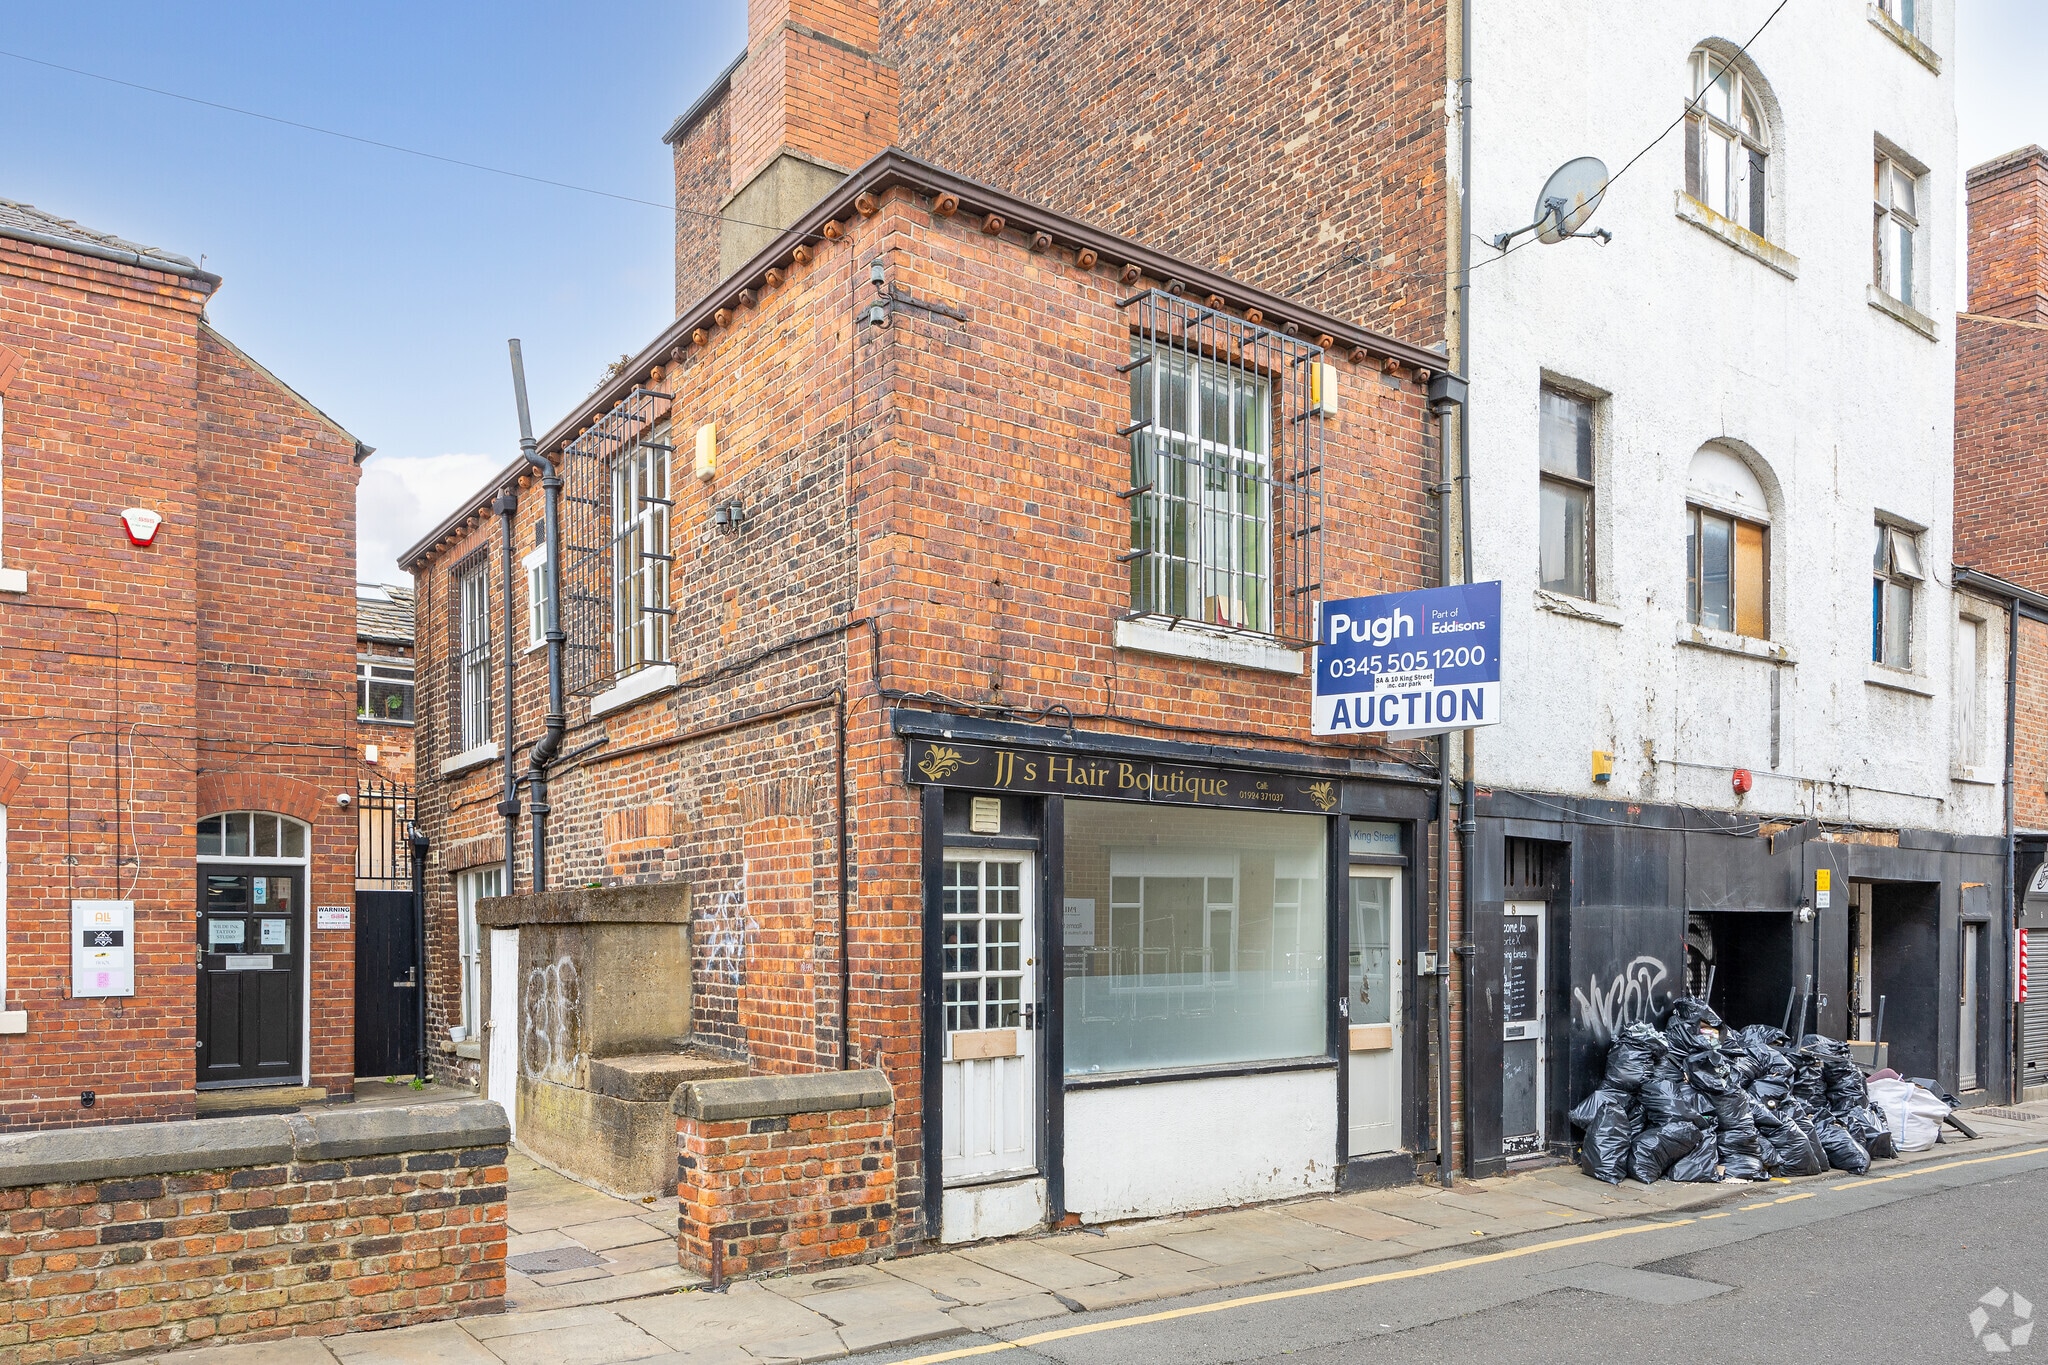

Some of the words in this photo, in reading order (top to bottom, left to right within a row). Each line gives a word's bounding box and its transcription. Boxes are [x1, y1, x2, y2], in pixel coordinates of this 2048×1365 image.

[1432, 609, 1448, 619] Part
[1450, 607, 1459, 618] of
[1330, 607, 1414, 647] Pugh
[1431, 620, 1486, 635] Eddisons
[1329, 655, 1382, 679] 0345
[1387, 650, 1428, 673] 505
[1432, 645, 1486, 669] 1200
[1414, 673, 1433, 681] Street
[1330, 687, 1484, 730] AUCTION
[1047, 756, 1110, 787] Hair
[1118, 762, 1229, 802] Boutique
[1239, 790, 1260, 800] 01924
[1260, 792, 1284, 802] 371037
[1354, 830, 1371, 844] King
[1373, 831, 1396, 842] Street
[1511, 903, 1517, 915] 8
